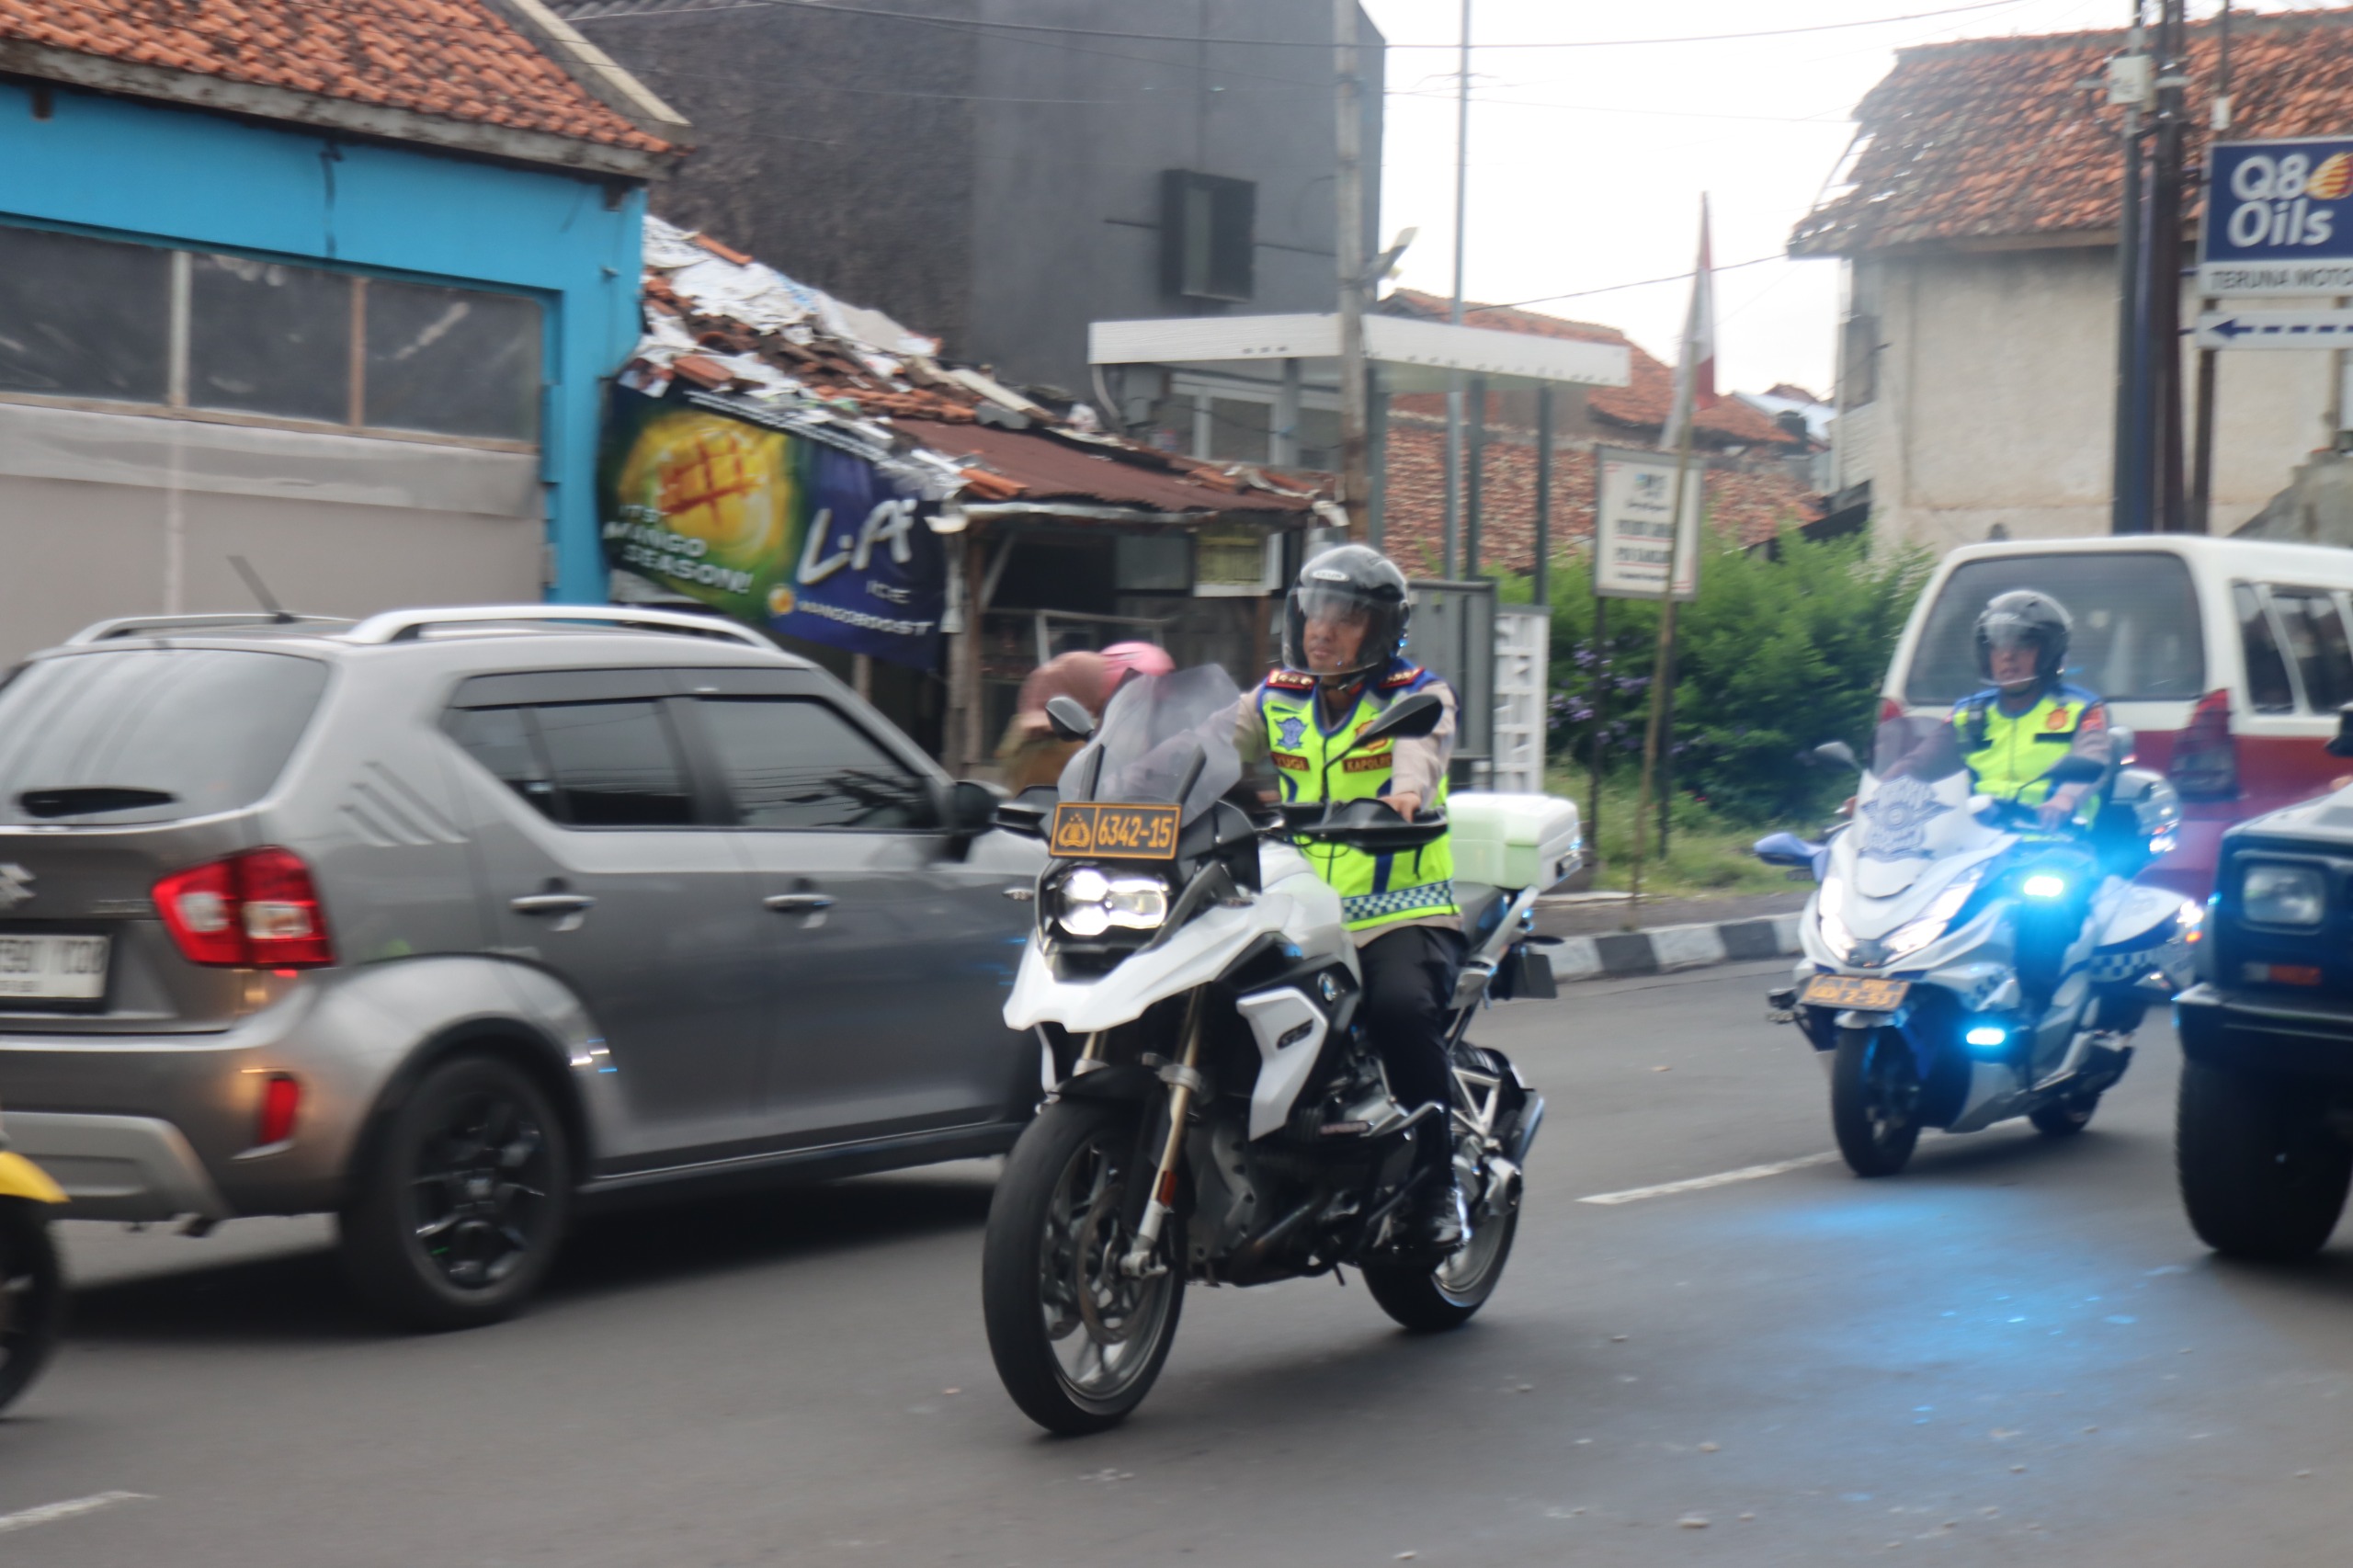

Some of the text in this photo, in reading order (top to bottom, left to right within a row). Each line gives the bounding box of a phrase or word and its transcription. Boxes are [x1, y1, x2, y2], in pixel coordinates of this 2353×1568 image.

[2230, 153, 2310, 201] Q8
[2226, 198, 2336, 247] Oils
[2211, 268, 2290, 291] TERUNA
[602, 520, 709, 558] MANGO
[866, 580, 913, 605] ICE
[797, 601, 934, 636] MANGOBOOST
[1097, 814, 1174, 848] 6342-15
